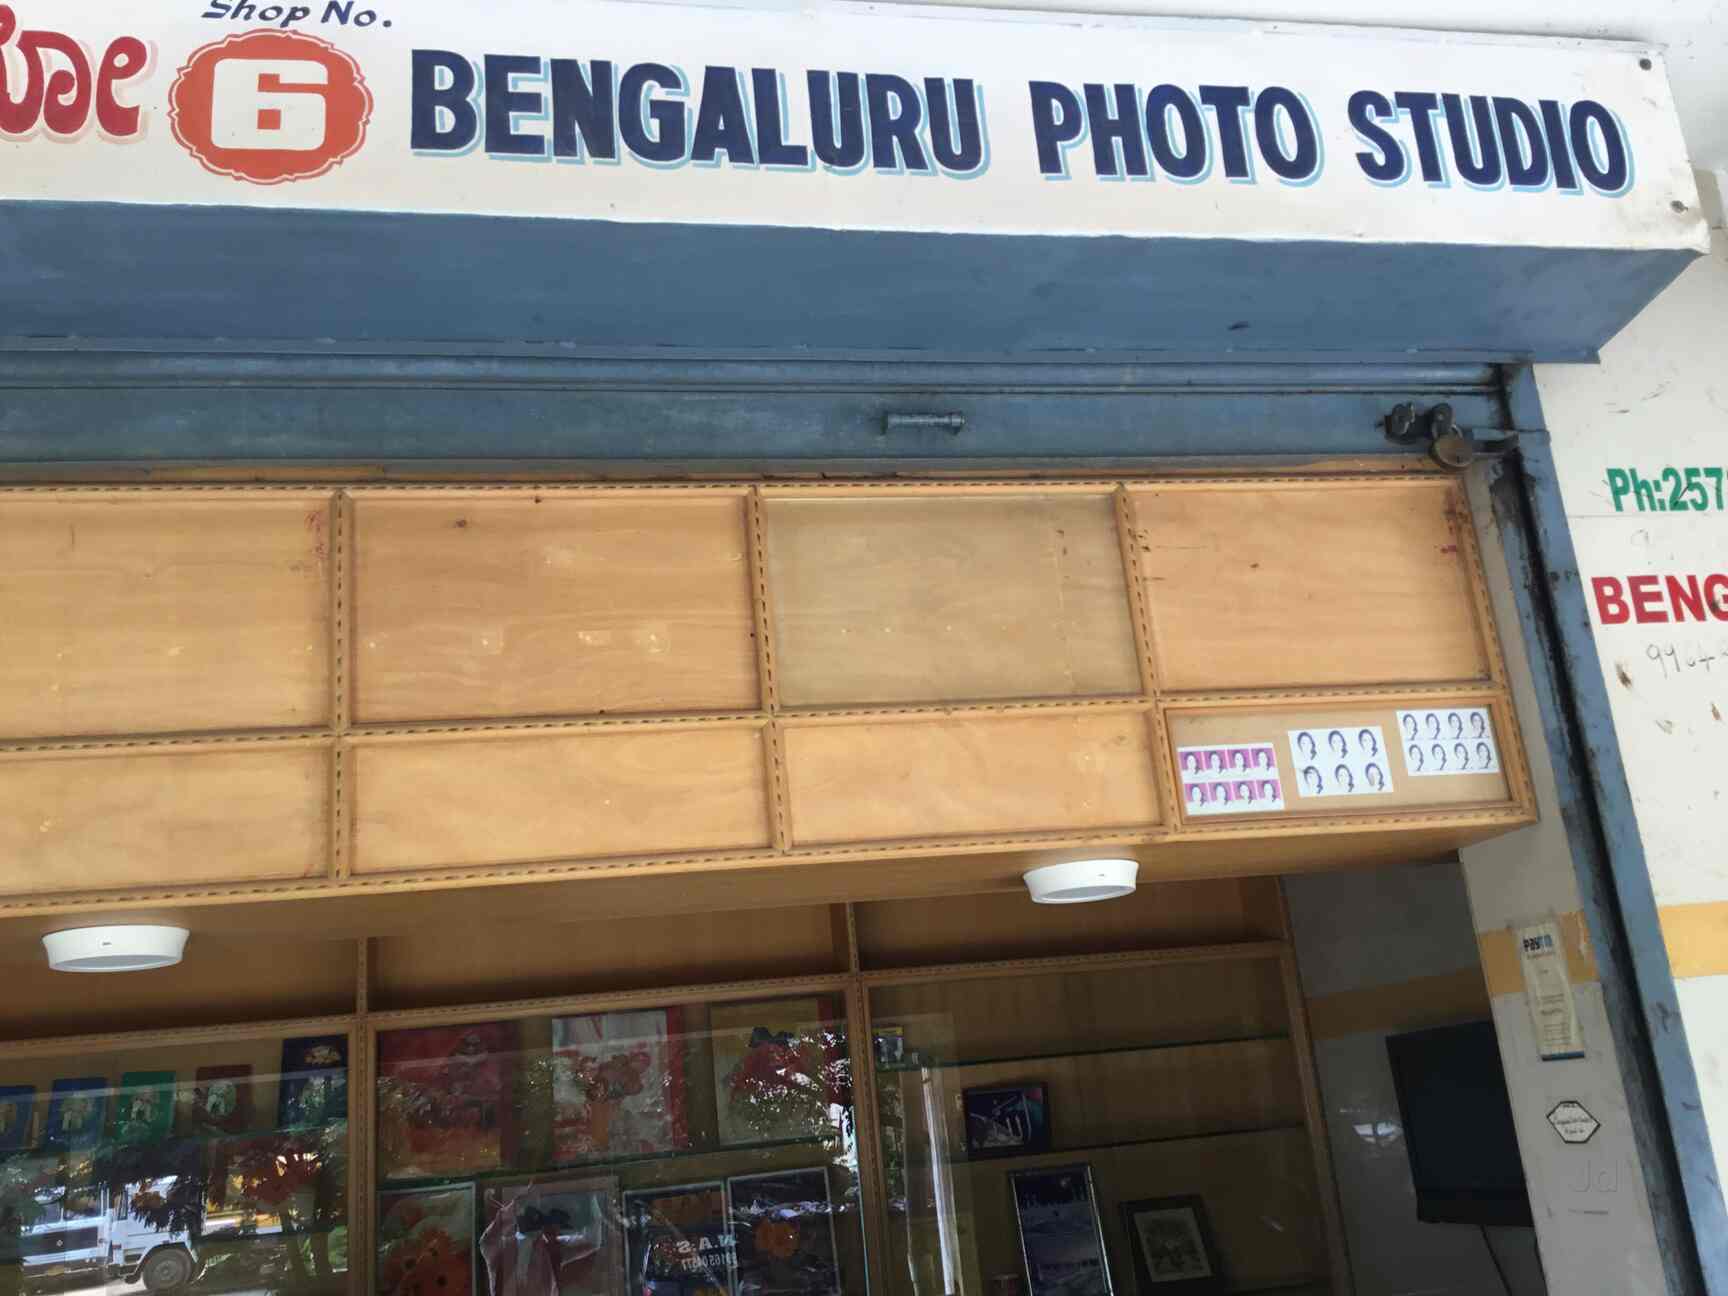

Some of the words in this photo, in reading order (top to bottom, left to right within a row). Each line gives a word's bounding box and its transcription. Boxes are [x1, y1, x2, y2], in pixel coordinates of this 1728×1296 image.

[201, 0, 310, 28] Shop
[320, 0, 392, 27] No.
[211, 58, 328, 150] 6
[411, 49, 988, 177] BENGALURU
[1028, 81, 1321, 184] PHOTO
[1347, 89, 1631, 194] STUDIO
[1606, 467, 1728, 511] Ph:257
[1591, 574, 1728, 625] BENG
